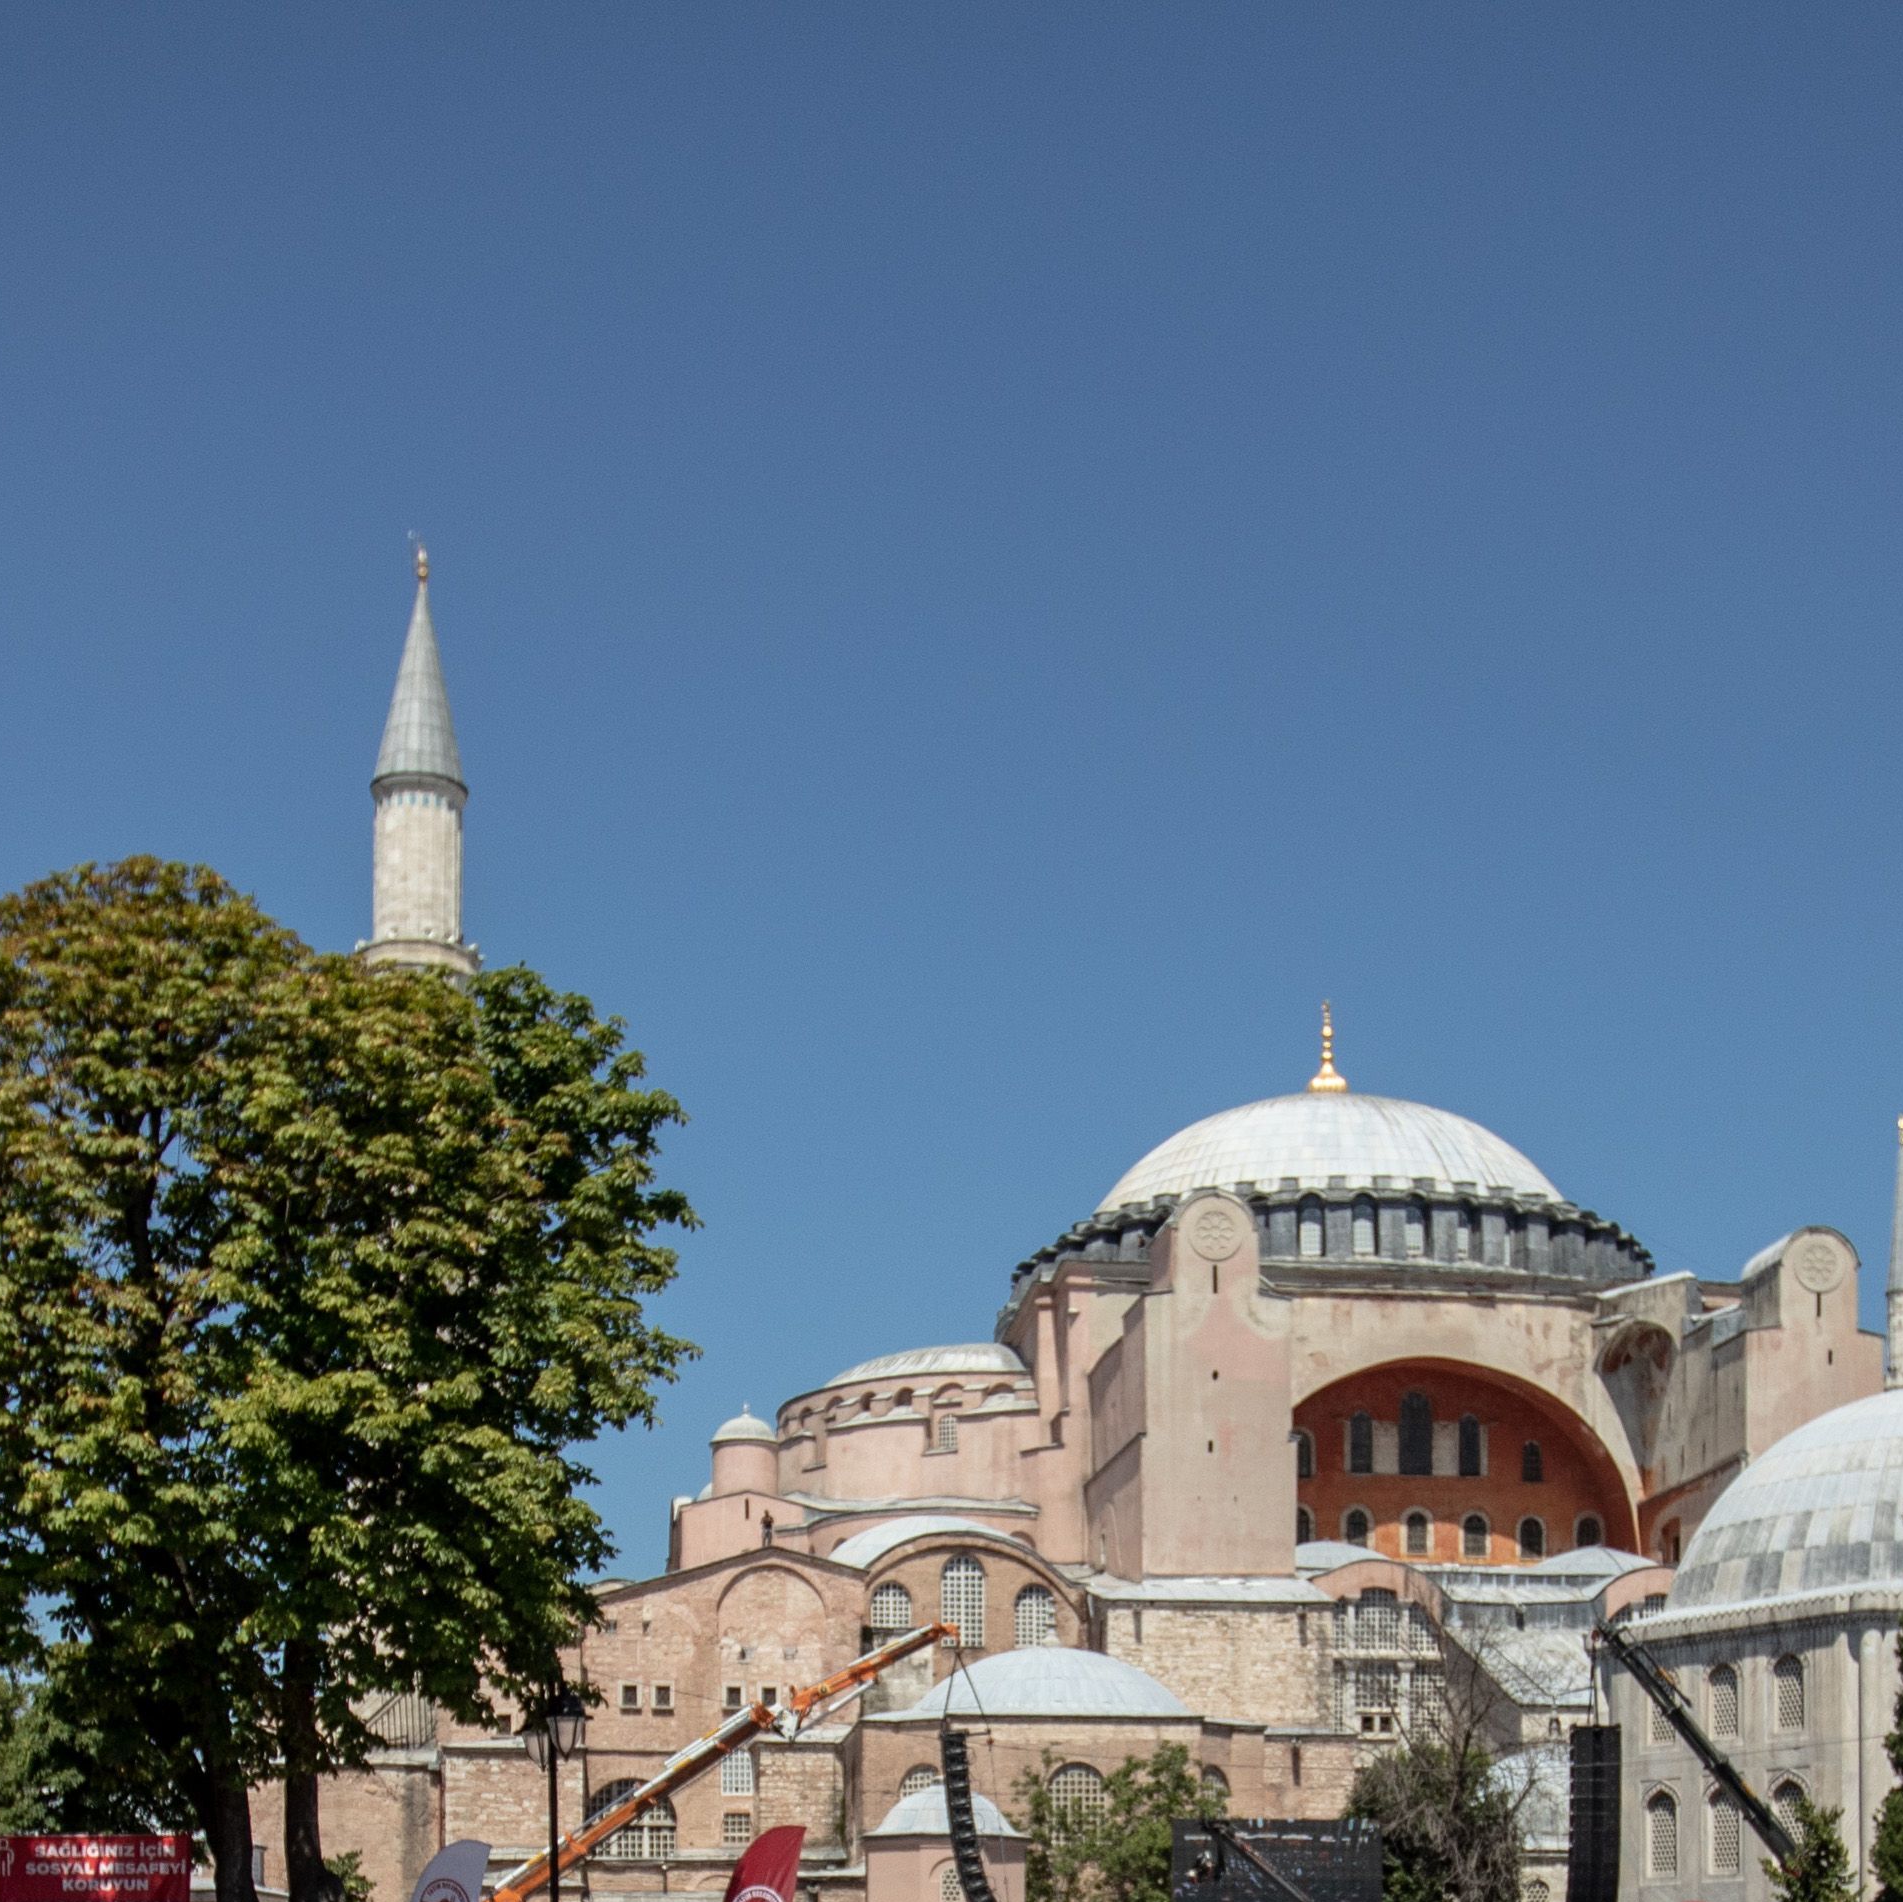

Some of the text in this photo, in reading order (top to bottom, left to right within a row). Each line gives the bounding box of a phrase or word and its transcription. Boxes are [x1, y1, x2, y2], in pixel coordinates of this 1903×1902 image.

[34, 1841, 176, 1860] SAĞLIĞINIZ İÇİN
[25, 1858, 187, 1876] SOSYAL MESAFEYİ
[62, 1879, 149, 1892] KORUYUN
